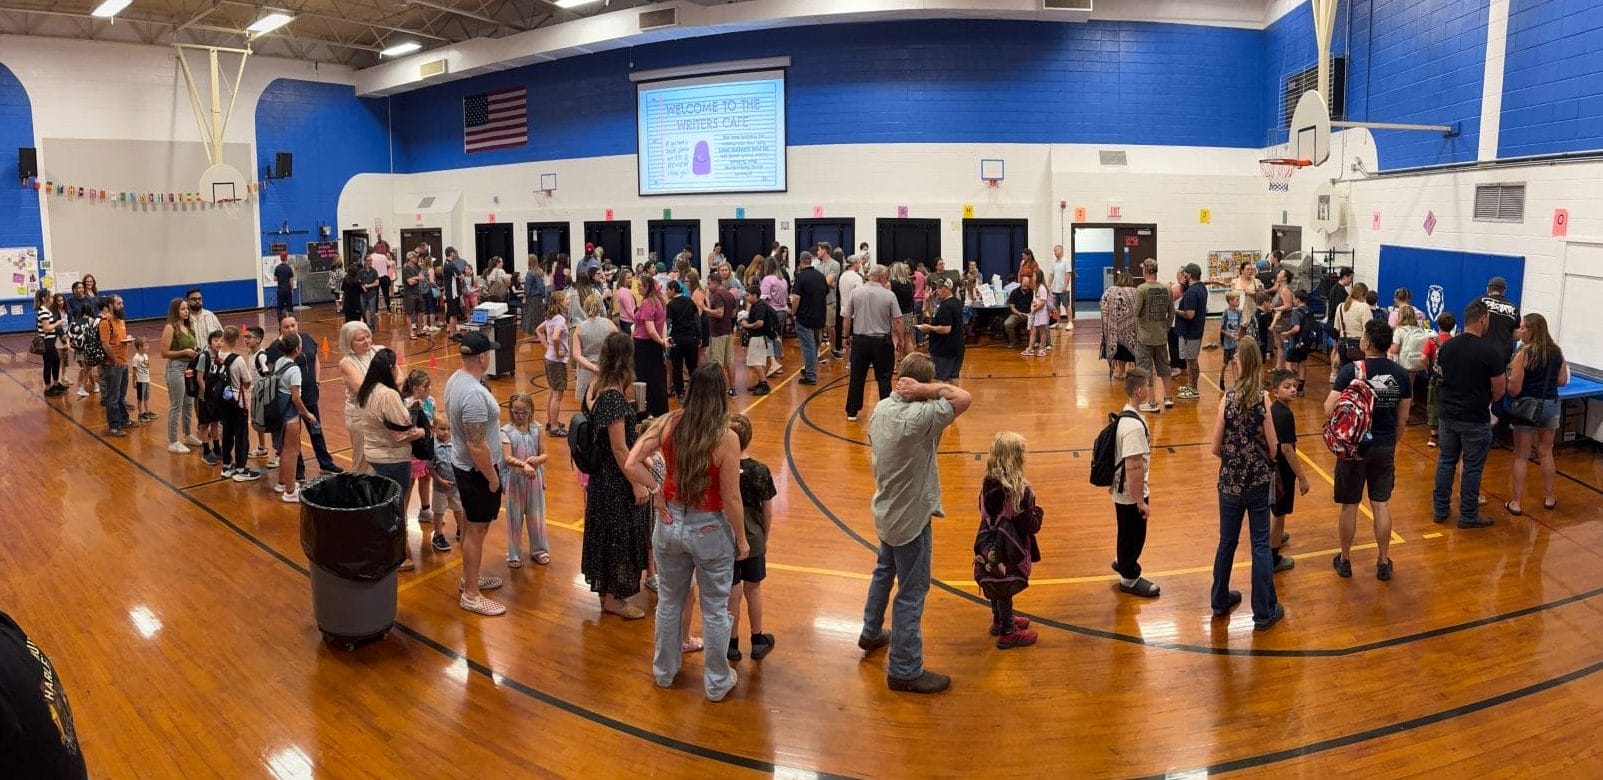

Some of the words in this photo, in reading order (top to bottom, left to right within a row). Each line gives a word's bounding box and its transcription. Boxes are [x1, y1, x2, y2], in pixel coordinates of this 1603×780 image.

[666, 102, 718, 116] WELCOME
[723, 99, 737, 112] TO
[741, 97, 760, 111] THE
[677, 117, 718, 130] WRITERS
[722, 116, 749, 128] CAFE
